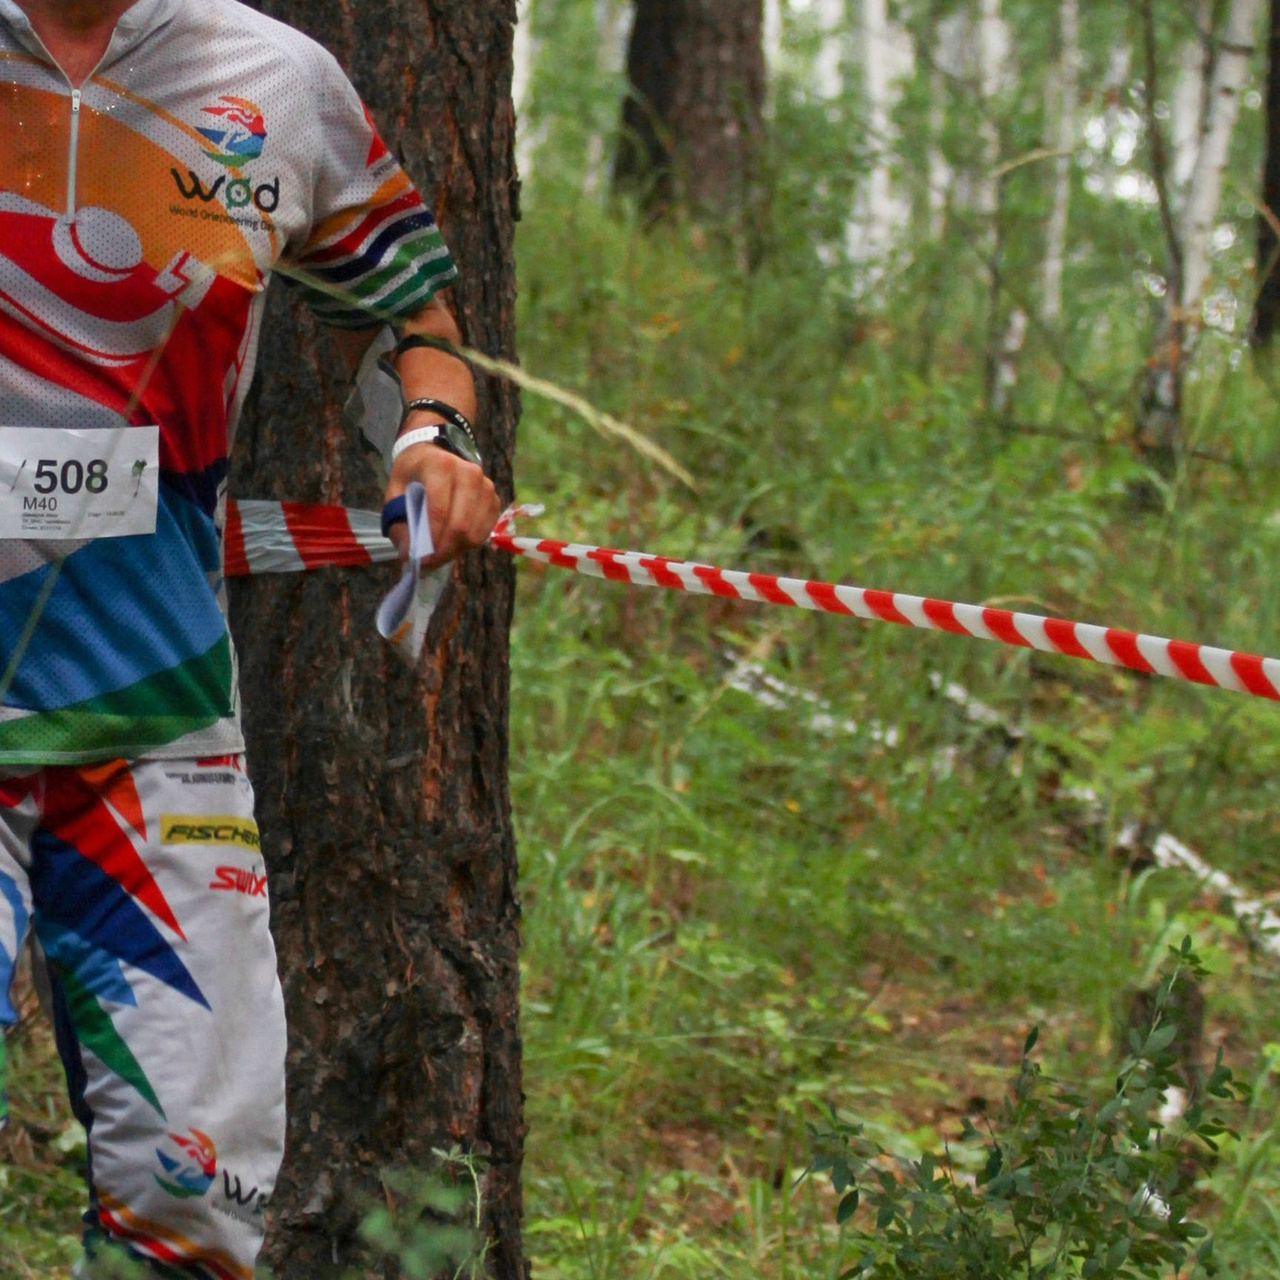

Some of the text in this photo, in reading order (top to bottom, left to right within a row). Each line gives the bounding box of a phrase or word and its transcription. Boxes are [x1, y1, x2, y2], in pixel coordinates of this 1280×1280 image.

[169, 205, 198, 218] World
[200, 209, 259, 232] Orienteering
[34, 459, 108, 494] 508
[23, 496, 58, 511] M40
